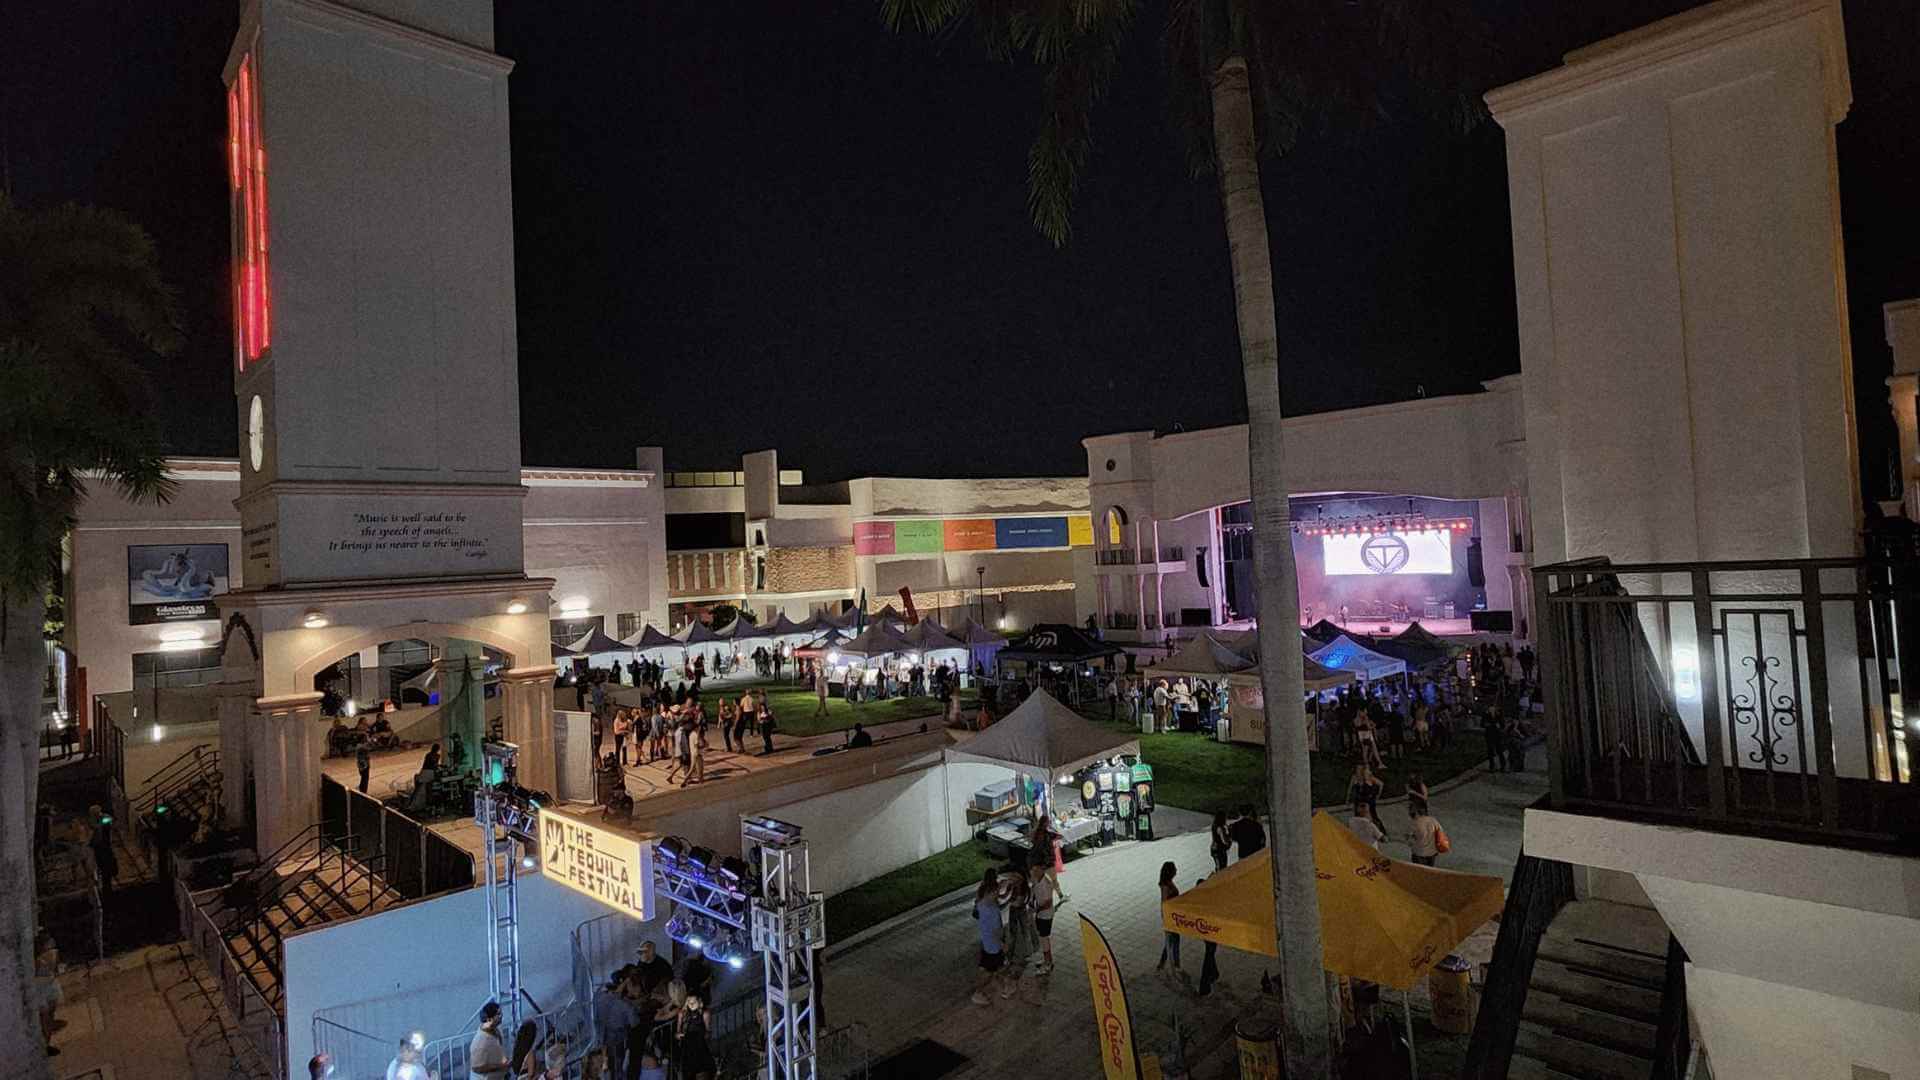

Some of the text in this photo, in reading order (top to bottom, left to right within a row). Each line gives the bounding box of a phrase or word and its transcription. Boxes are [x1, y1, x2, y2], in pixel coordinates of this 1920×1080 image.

[402, 513, 421, 523] well
[456, 512, 467, 522] be
[361, 526, 376, 536] the
[378, 525, 409, 538] speech
[411, 527, 421, 539] of
[340, 540, 372, 553] brings
[433, 539, 448, 548] the
[567, 823, 593, 850] THE
[568, 845, 630, 887] TEQUILA
[569, 866, 642, 912] FESTIVAL
[1093, 954, 1125, 1073] Topo Chico
